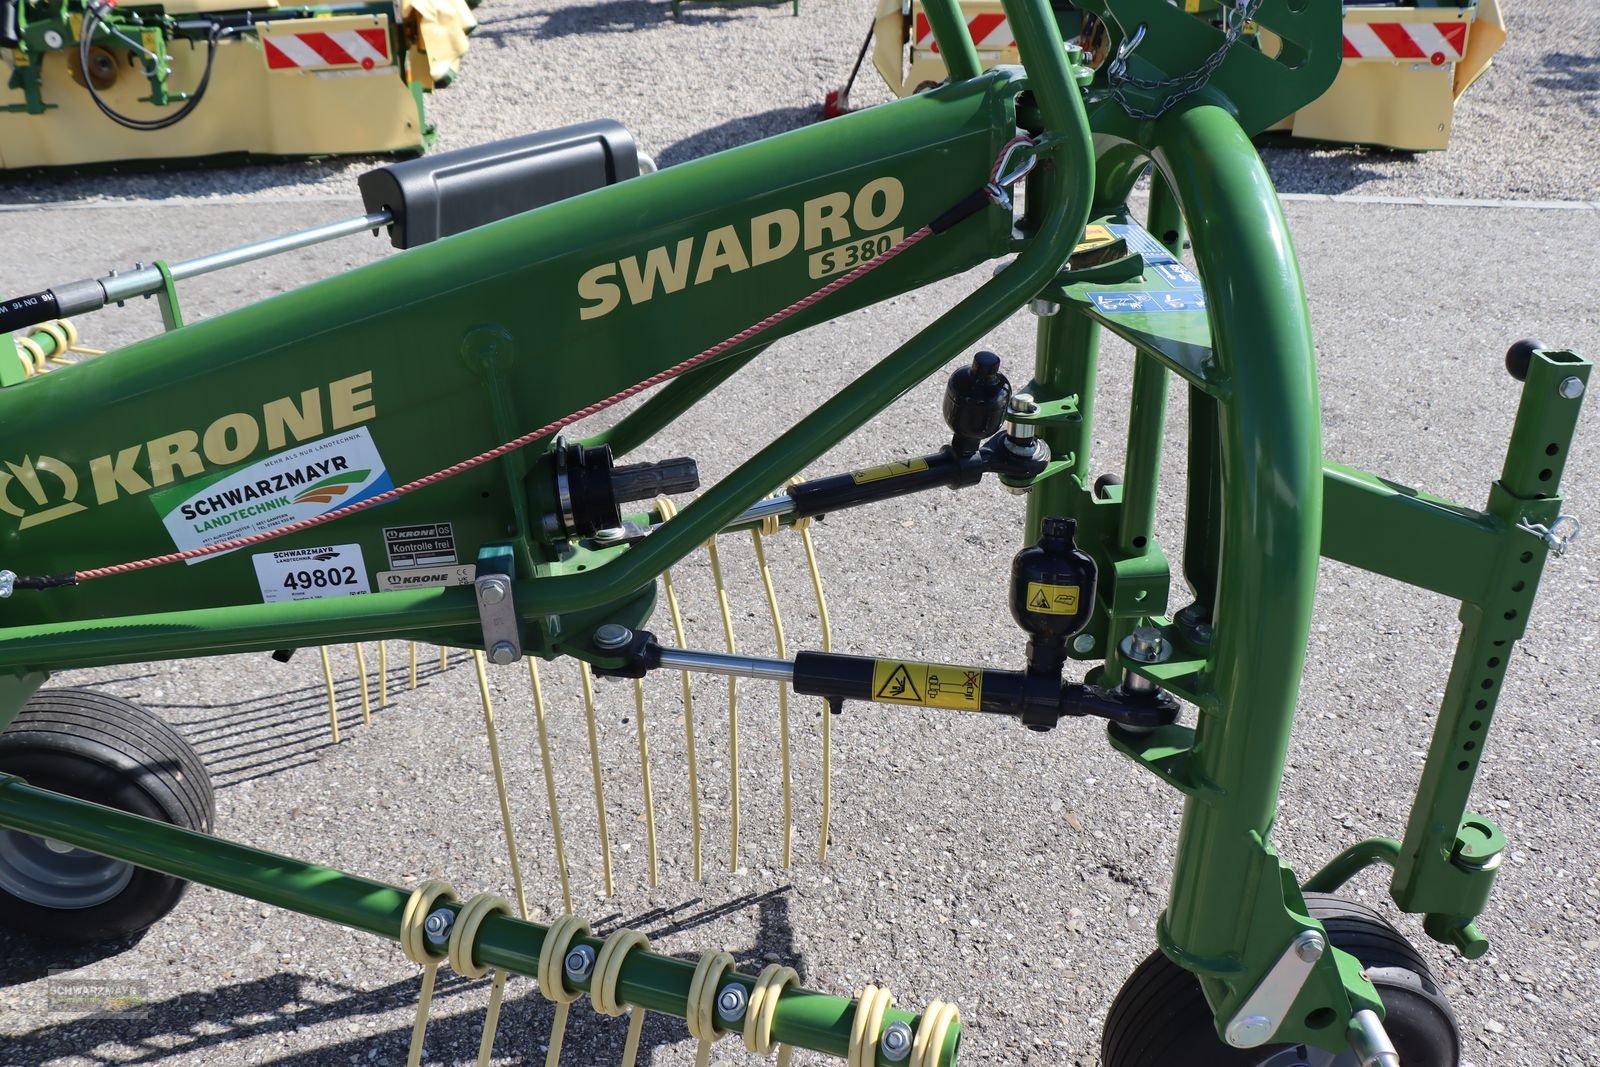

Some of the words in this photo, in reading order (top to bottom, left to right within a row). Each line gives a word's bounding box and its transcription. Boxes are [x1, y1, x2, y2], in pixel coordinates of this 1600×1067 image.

[577, 176, 905, 321] SWADRO
[821, 252, 835, 274] S
[845, 235, 891, 267] 380
[12, 302, 23, 310] 16
[23, 297, 38, 307] DN
[89, 371, 377, 505] KRONE
[264, 458, 283, 468] MEHR
[285, 453, 298, 462] ALS
[299, 448, 313, 457] NUR
[315, 433, 361, 452] LANDTECHNIK
[180, 455, 349, 521] SCHWARZMAYR
[194, 495, 291, 534] LANDTECHNIK
[398, 528, 435, 538] KRONE
[438, 526, 450, 535] QS
[273, 546, 334, 559] SCHWARZMAYR
[393, 541, 433, 553] Kontrolle
[434, 540, 450, 549] frei
[276, 556, 311, 564] LANDTECHNIK
[283, 566, 358, 590] 49802
[403, 573, 449, 584] KRONE
